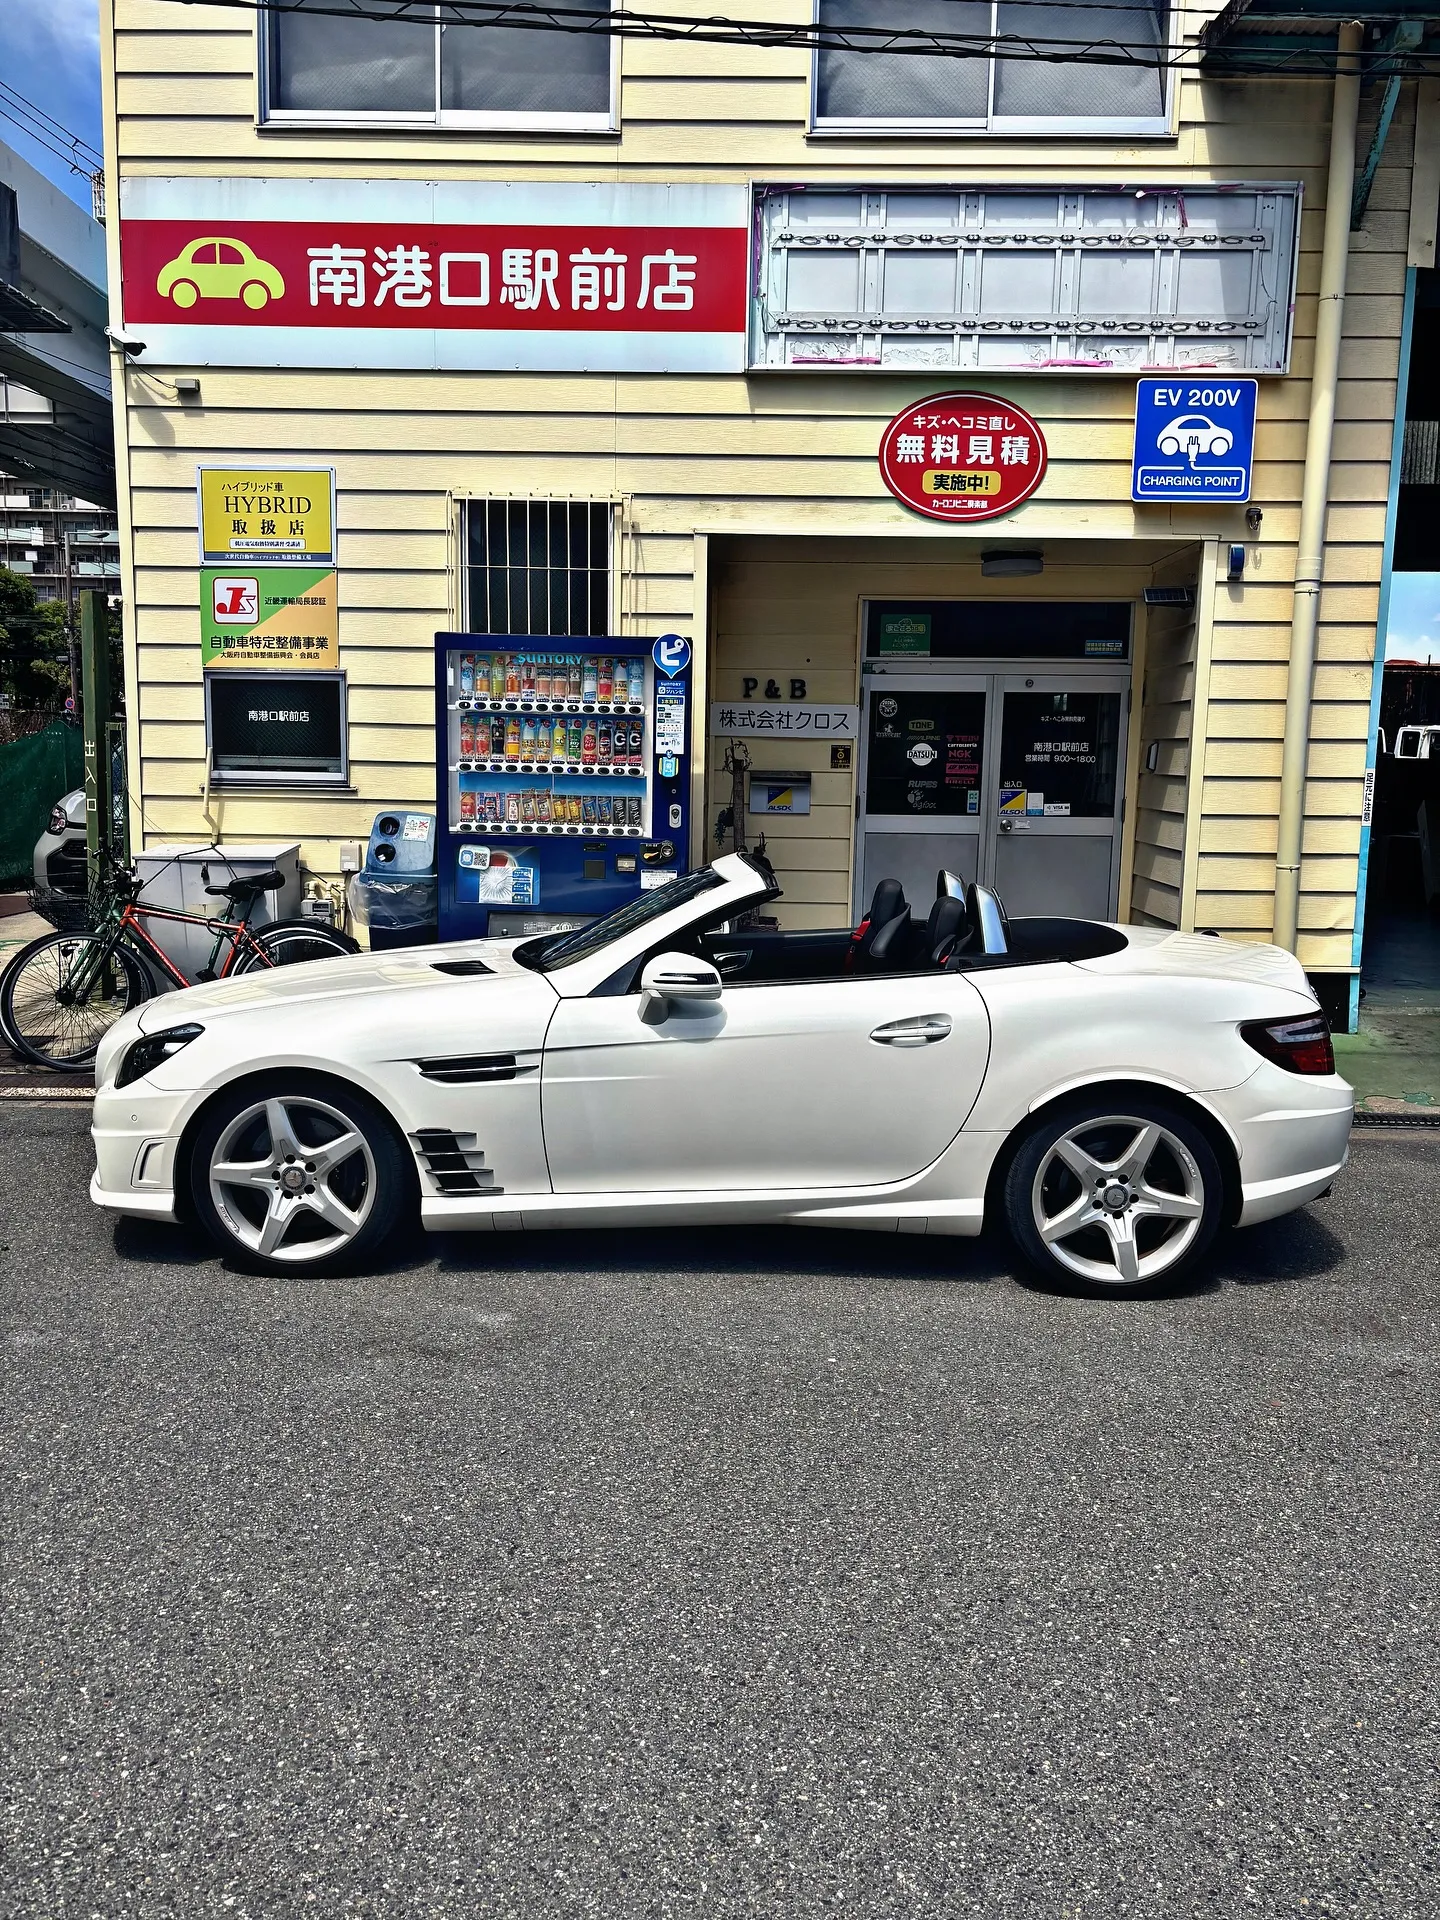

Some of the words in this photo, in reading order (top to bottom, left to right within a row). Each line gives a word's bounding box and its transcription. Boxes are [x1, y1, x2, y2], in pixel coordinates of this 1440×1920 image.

[306, 243, 698, 312] 南港口駅前店
[1154, 388, 1181, 407] EV
[1188, 388, 1241, 407] 200V
[913, 415, 1016, 430] キズ・ヘコミ直し
[896, 434, 1030, 466] 無料見積
[221, 482, 284, 493] ハイブリッド車
[932, 473, 989, 492] 実施中!
[1143, 475, 1201, 487] CHARGING
[1204, 475, 1240, 487] POINT
[224, 496, 311, 514] HYBRID
[232, 519, 304, 536] 取扱店
[264, 597, 326, 606] 近畿運輸局長認証
[211, 636, 329, 650] 自動車特定整備事業
[517, 653, 582, 665] SUNTORY
[742, 677, 759, 698] P
[764, 679, 781, 699] &
[790, 679, 807, 699] B
[248, 710, 310, 722] 南港口駅前店
[719, 709, 849, 730] 株式会社クロス
[910, 721, 933, 729] TONE
[948, 749, 972, 758] NGK
[1033, 742, 1090, 752] 南港口駅前店
[908, 750, 936, 759] DATSUN
[84, 740, 97, 812] 出入口
[1003, 780, 1023, 788] 出入口
